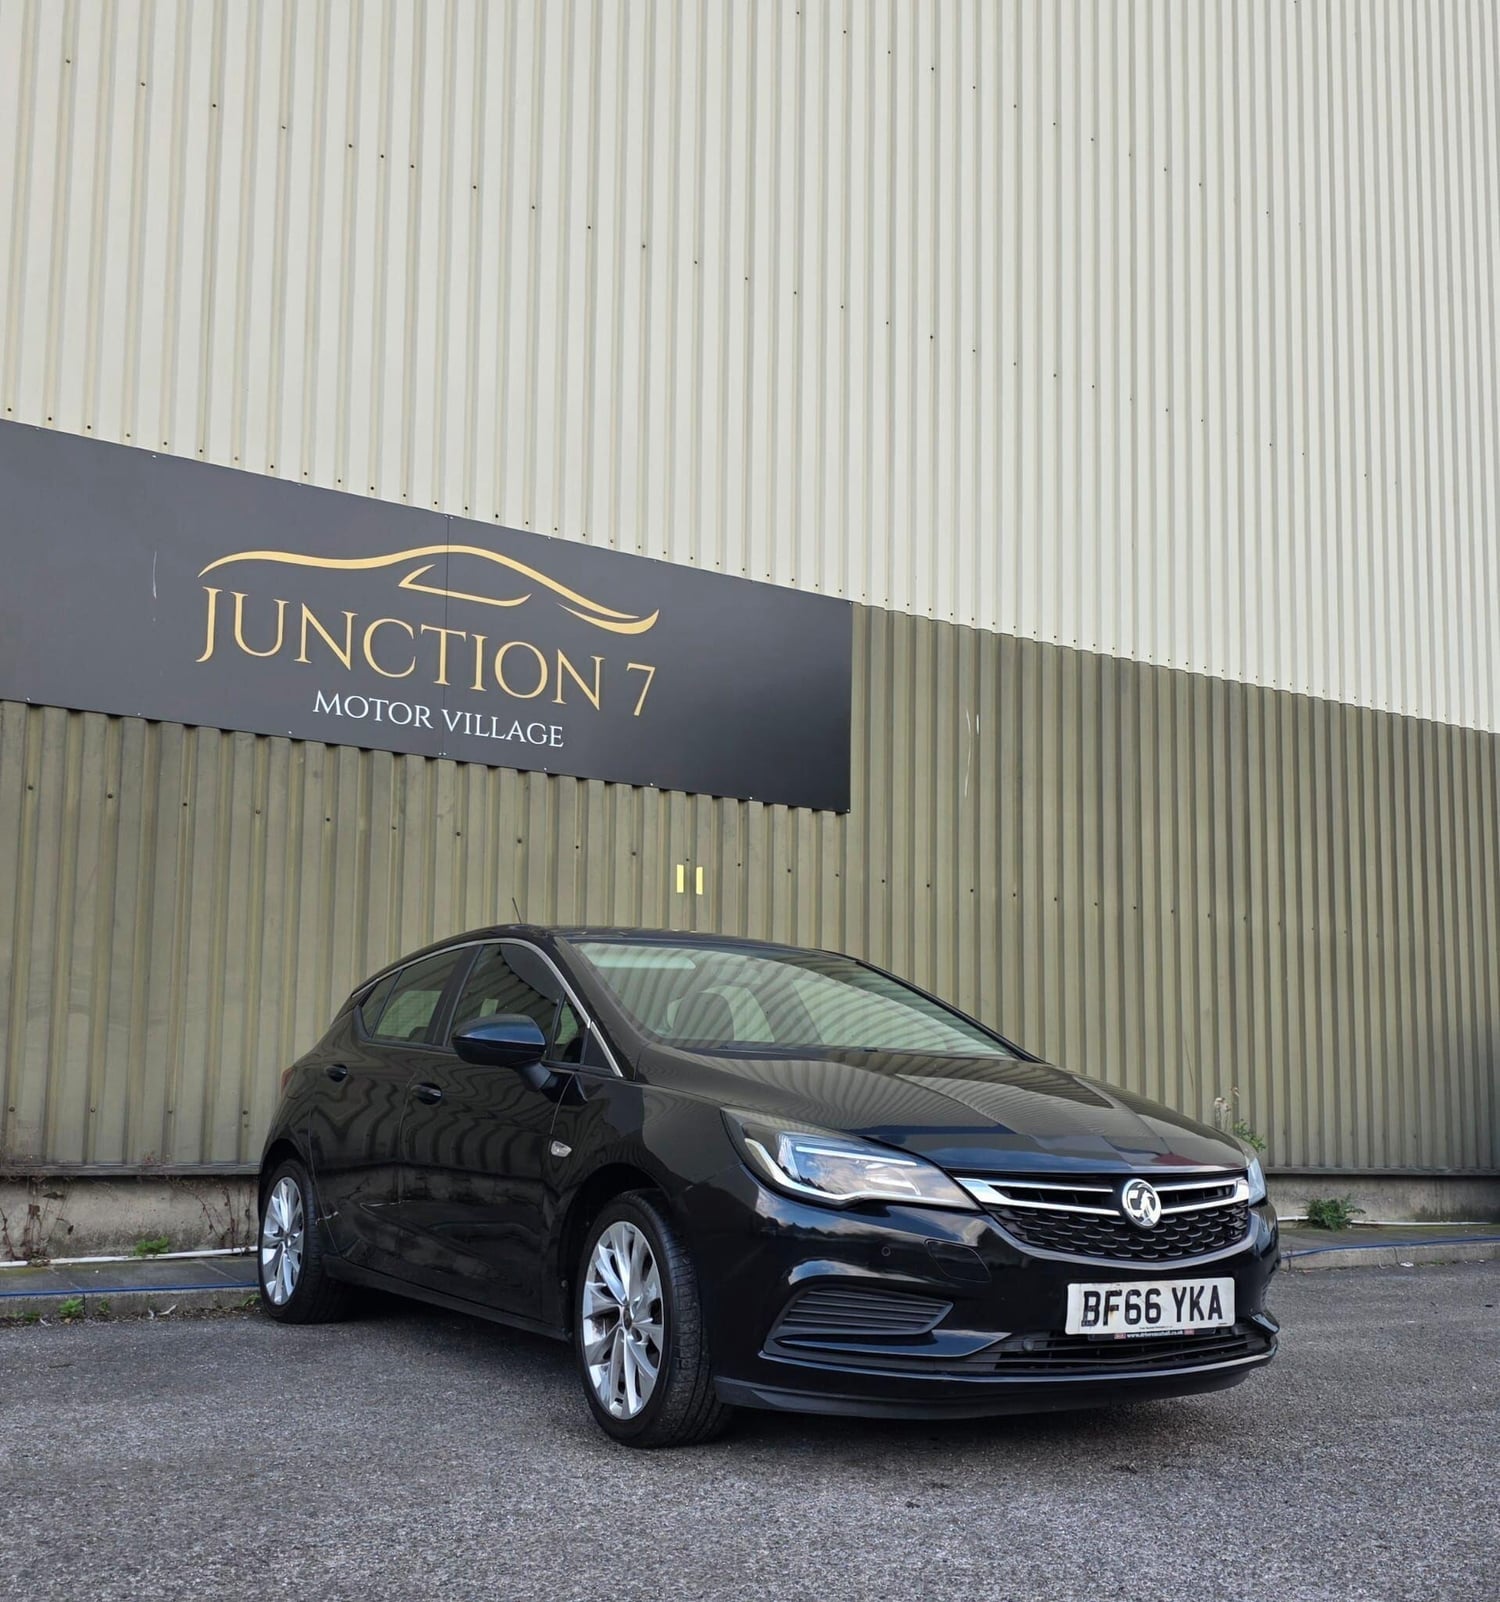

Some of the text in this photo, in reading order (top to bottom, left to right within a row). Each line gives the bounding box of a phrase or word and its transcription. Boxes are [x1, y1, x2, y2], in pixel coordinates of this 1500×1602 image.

[195, 586, 657, 716] JUNCTION 7
[312, 690, 565, 748] MOTOR VILLAGE
[1081, 1285, 1223, 1327] BF66 YKA
